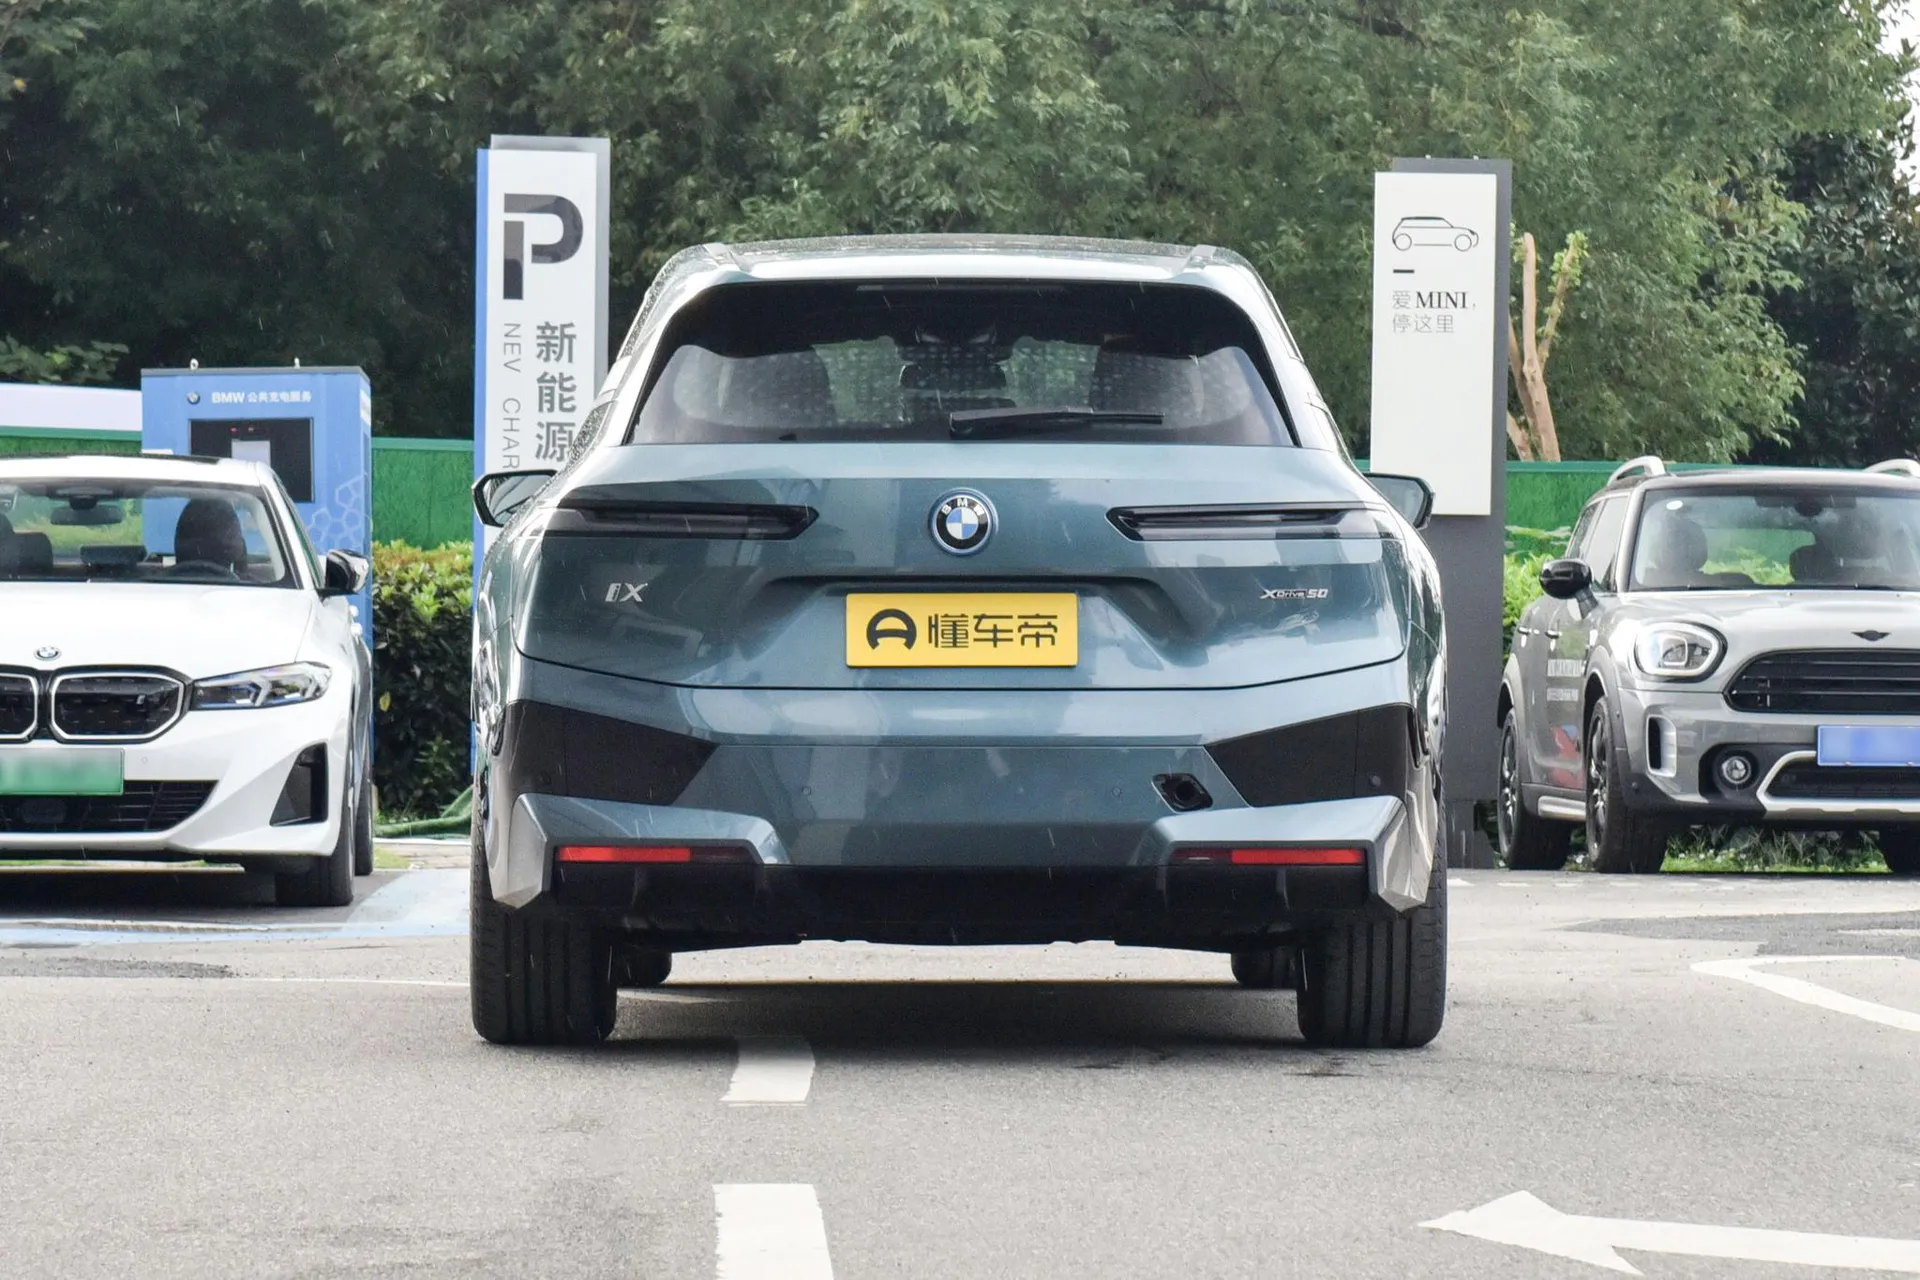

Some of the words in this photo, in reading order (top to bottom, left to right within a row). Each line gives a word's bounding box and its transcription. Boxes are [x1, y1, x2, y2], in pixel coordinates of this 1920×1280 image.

[503, 193, 584, 300] P
[1392, 313, 1456, 334] 停这里
[503, 322, 522, 373] NEV
[211, 391, 245, 404] BMW
[535, 321, 577, 462] 新能源
[605, 582, 648, 602] iX
[928, 613, 1058, 648] 懂车帝
